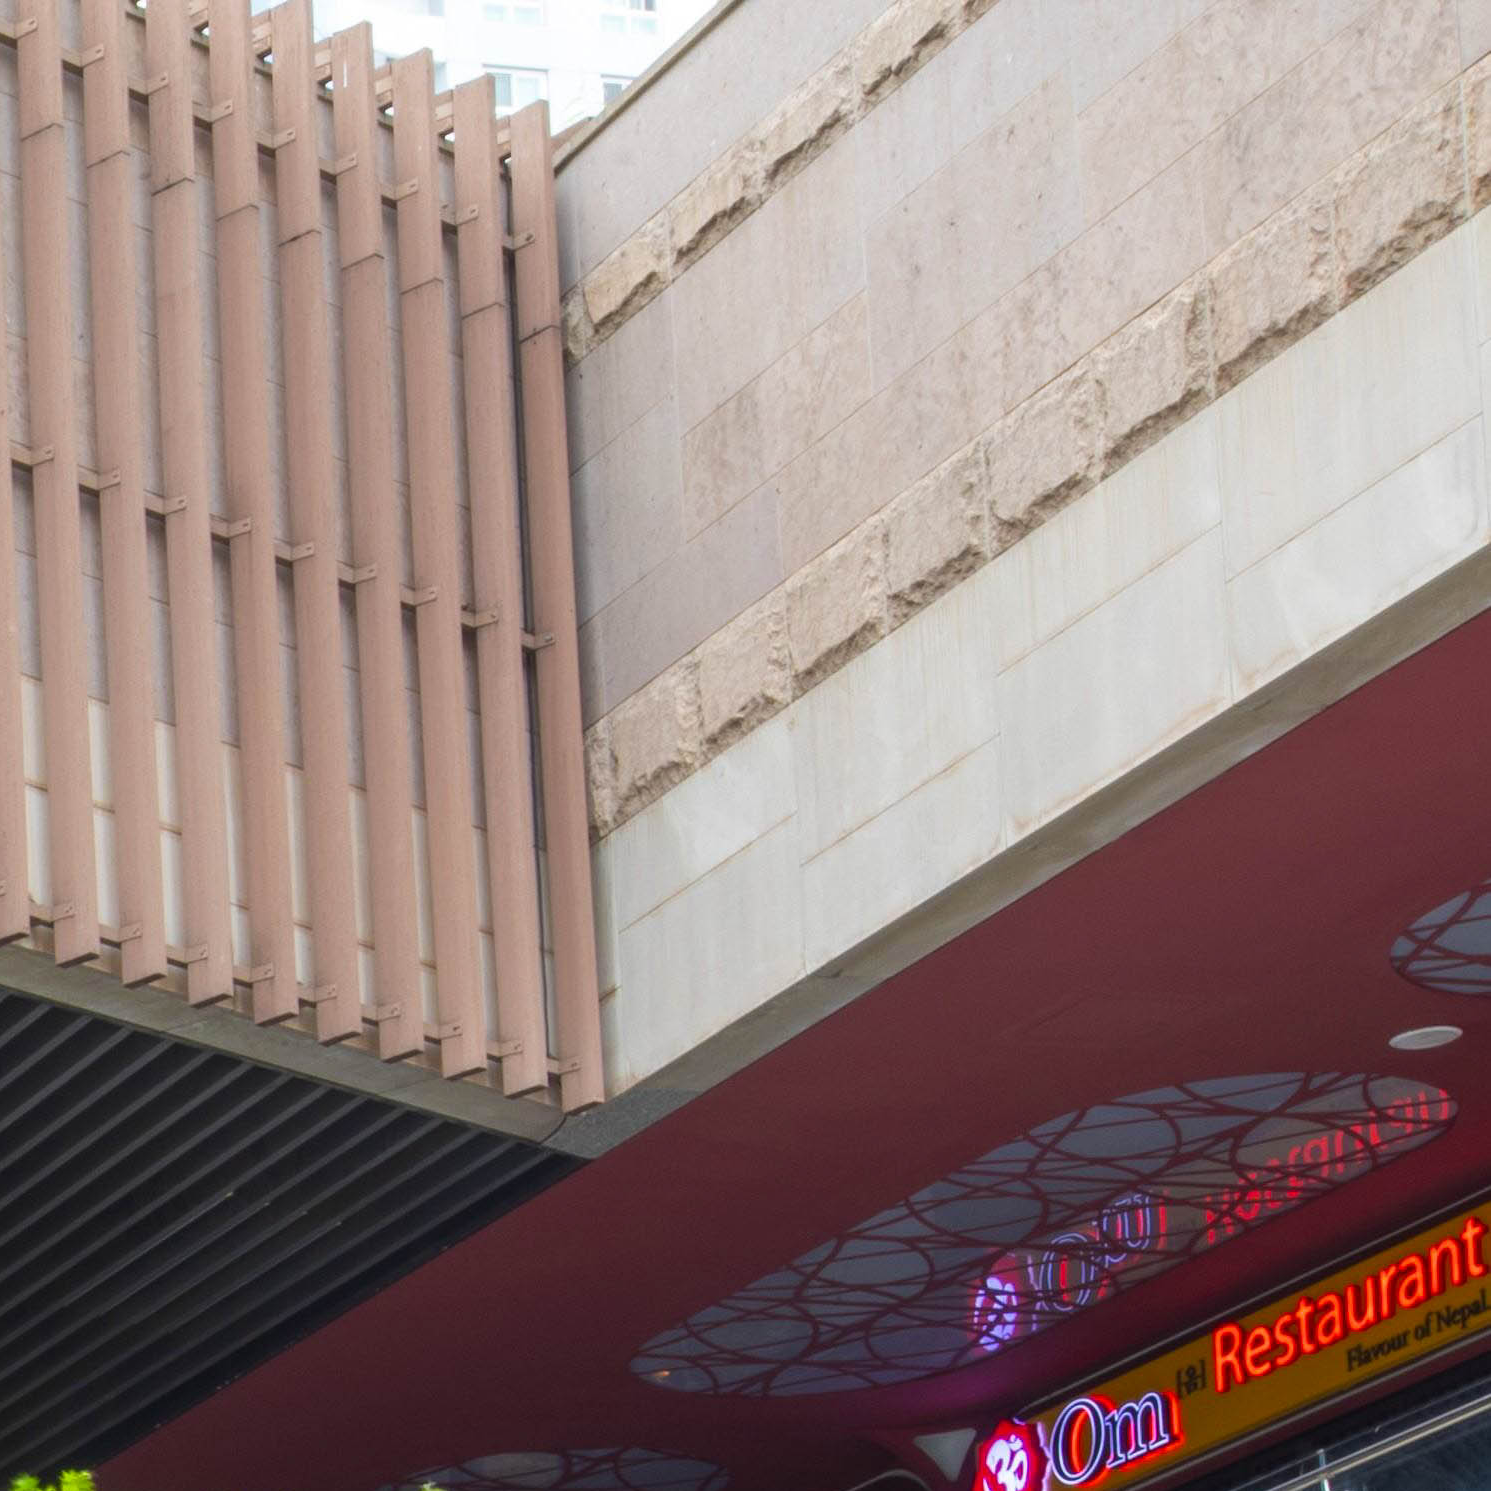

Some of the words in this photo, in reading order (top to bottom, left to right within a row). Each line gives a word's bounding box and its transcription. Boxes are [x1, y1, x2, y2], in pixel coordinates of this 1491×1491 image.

[1049, 1390, 1181, 1487] Om
[1212, 1215, 1488, 1395] Restaurant
[1413, 1311, 1439, 1341] of
